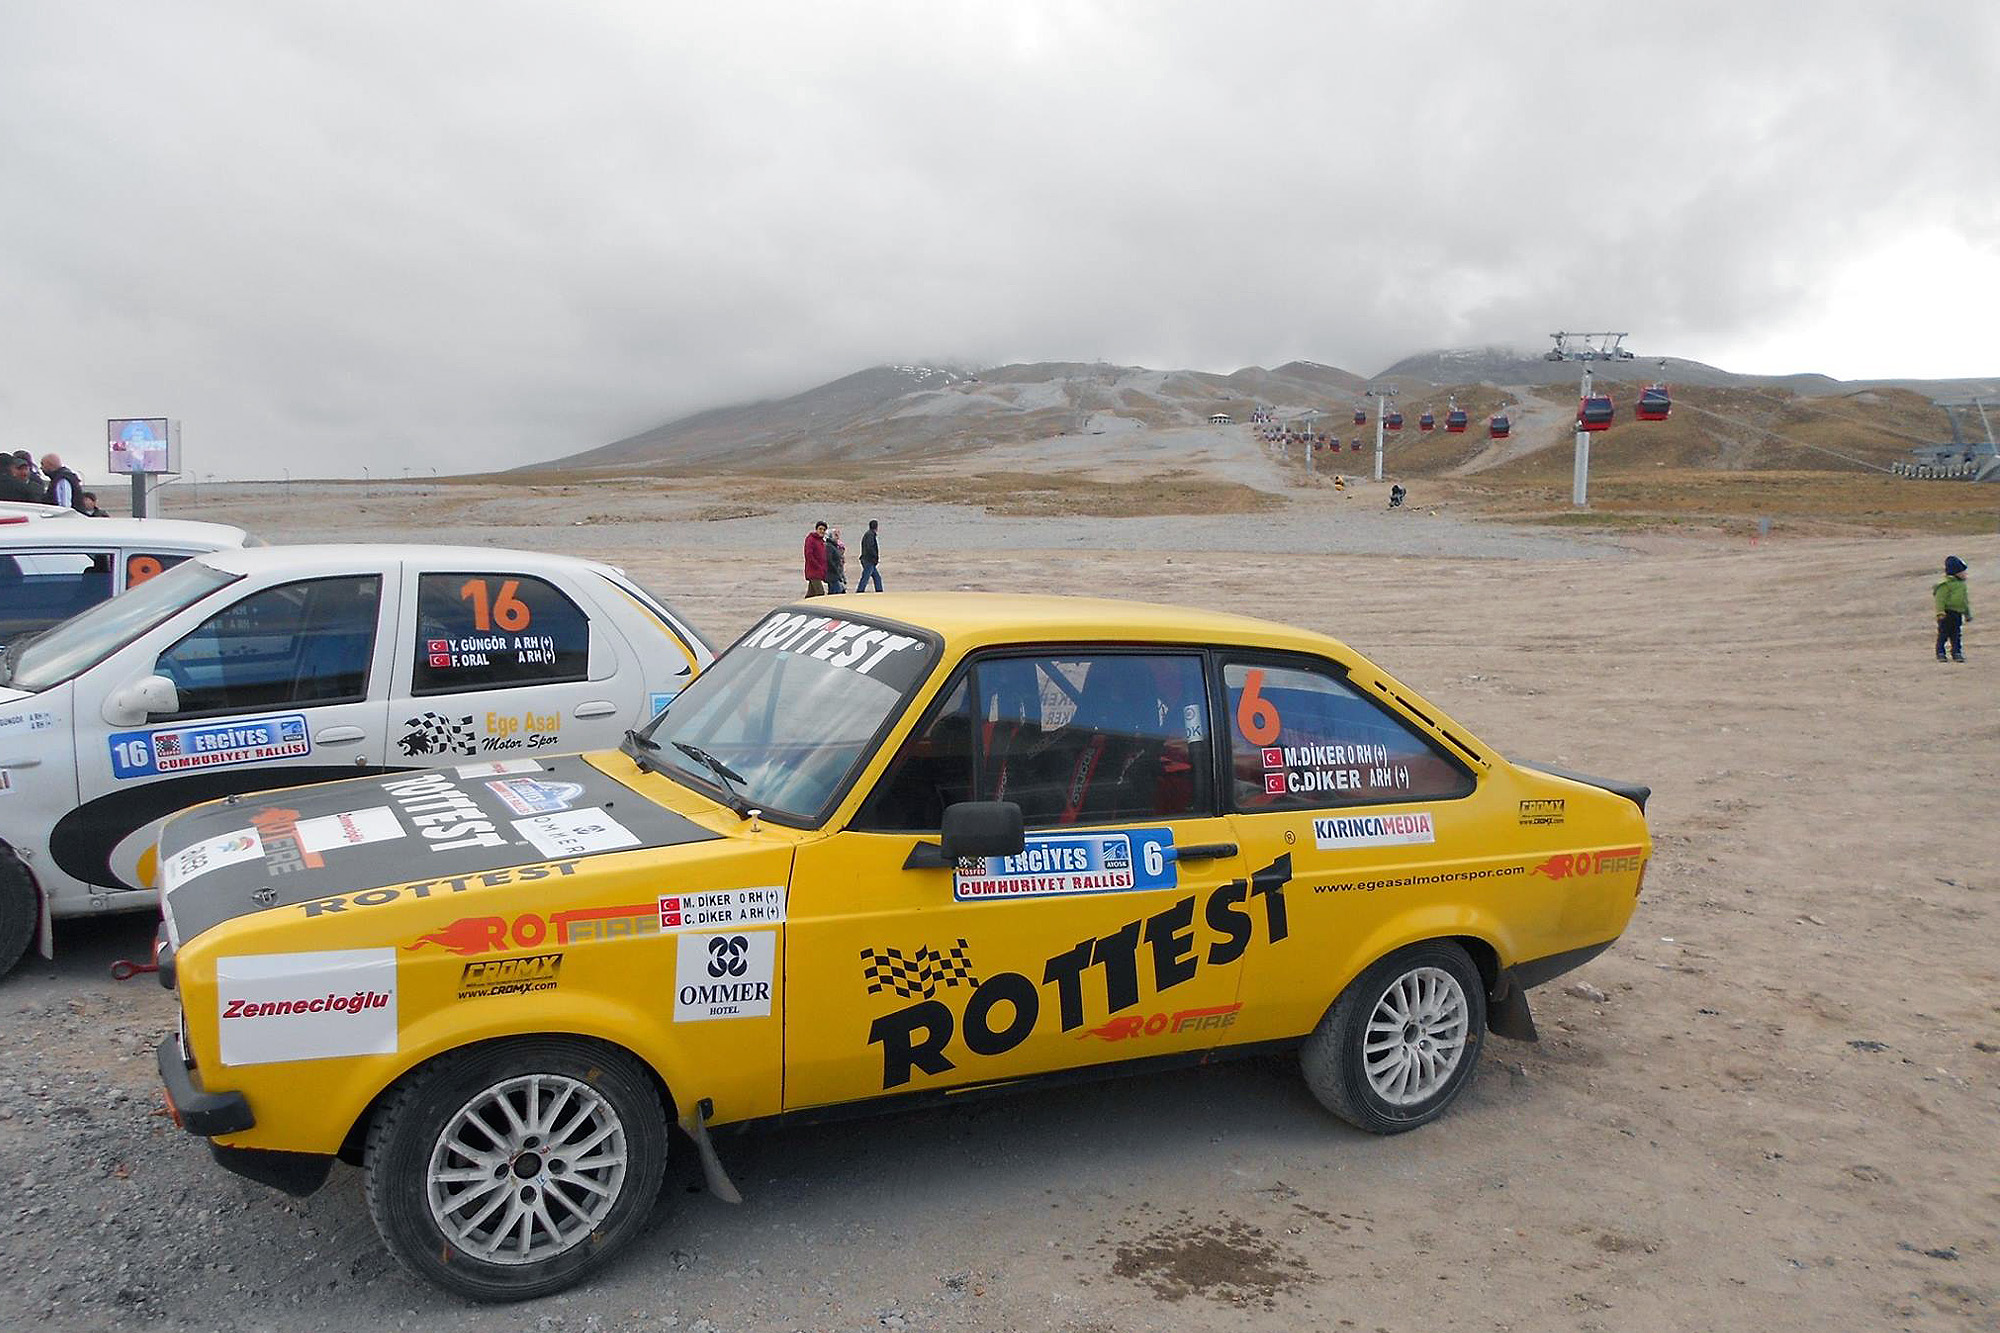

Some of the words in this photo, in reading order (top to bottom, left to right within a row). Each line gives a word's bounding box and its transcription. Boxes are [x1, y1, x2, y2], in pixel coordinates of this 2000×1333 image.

[460, 579, 530, 632] 16
[450, 639, 459, 652] Y.
[461, 636, 507, 651] GÜNGÖR
[514, 637, 523, 649] A
[524, 636, 539, 649] RH
[741, 612, 917, 675] ROTTEST
[452, 655, 461, 668] F.
[462, 652, 490, 667] ORAL
[518, 651, 527, 664] A
[527, 651, 542, 663] RH
[1237, 669, 1280, 745] 6
[486, 711, 519, 739] Ege
[525, 711, 560, 732] Asal
[196, 729, 269, 751] ERCİYES
[482, 737, 522, 751] Motor
[528, 734, 559, 749] Spor
[114, 740, 149, 768] 16
[159, 750, 249, 770] CUMHURİYET
[256, 743, 306, 757] RALLİSİ
[1357, 745, 1373, 764] RH
[381, 774, 508, 851] ROTTEST
[1315, 815, 1430, 839] KARINCAMEDIA
[1004, 844, 1088, 873] ERCİYES
[1143, 841, 1164, 876] 6
[299, 860, 581, 918] ROTTEST
[959, 876, 1066, 896] CUMHURİYET
[1072, 871, 1132, 889] RALLİSİ
[1313, 865, 1525, 894] www.egeasalmotorspor.com
[683, 897, 695, 909] M.
[698, 894, 730, 907] DİKER
[748, 892, 763, 903] RH
[765, 890, 778, 904] (+)
[684, 914, 695, 925] C.
[698, 909, 732, 923] DİKER
[740, 908, 748, 919] A
[750, 908, 764, 918] RH
[766, 906, 779, 920] (+)
[463, 954, 562, 980] CROMX
[868, 852, 1293, 1090] ROTTEST
[458, 981, 558, 1000] www.CROMX.com
[680, 981, 769, 1006] OMMER
[223, 991, 389, 1018] Zennecioğlu
[709, 1006, 740, 1016] HOTEL
